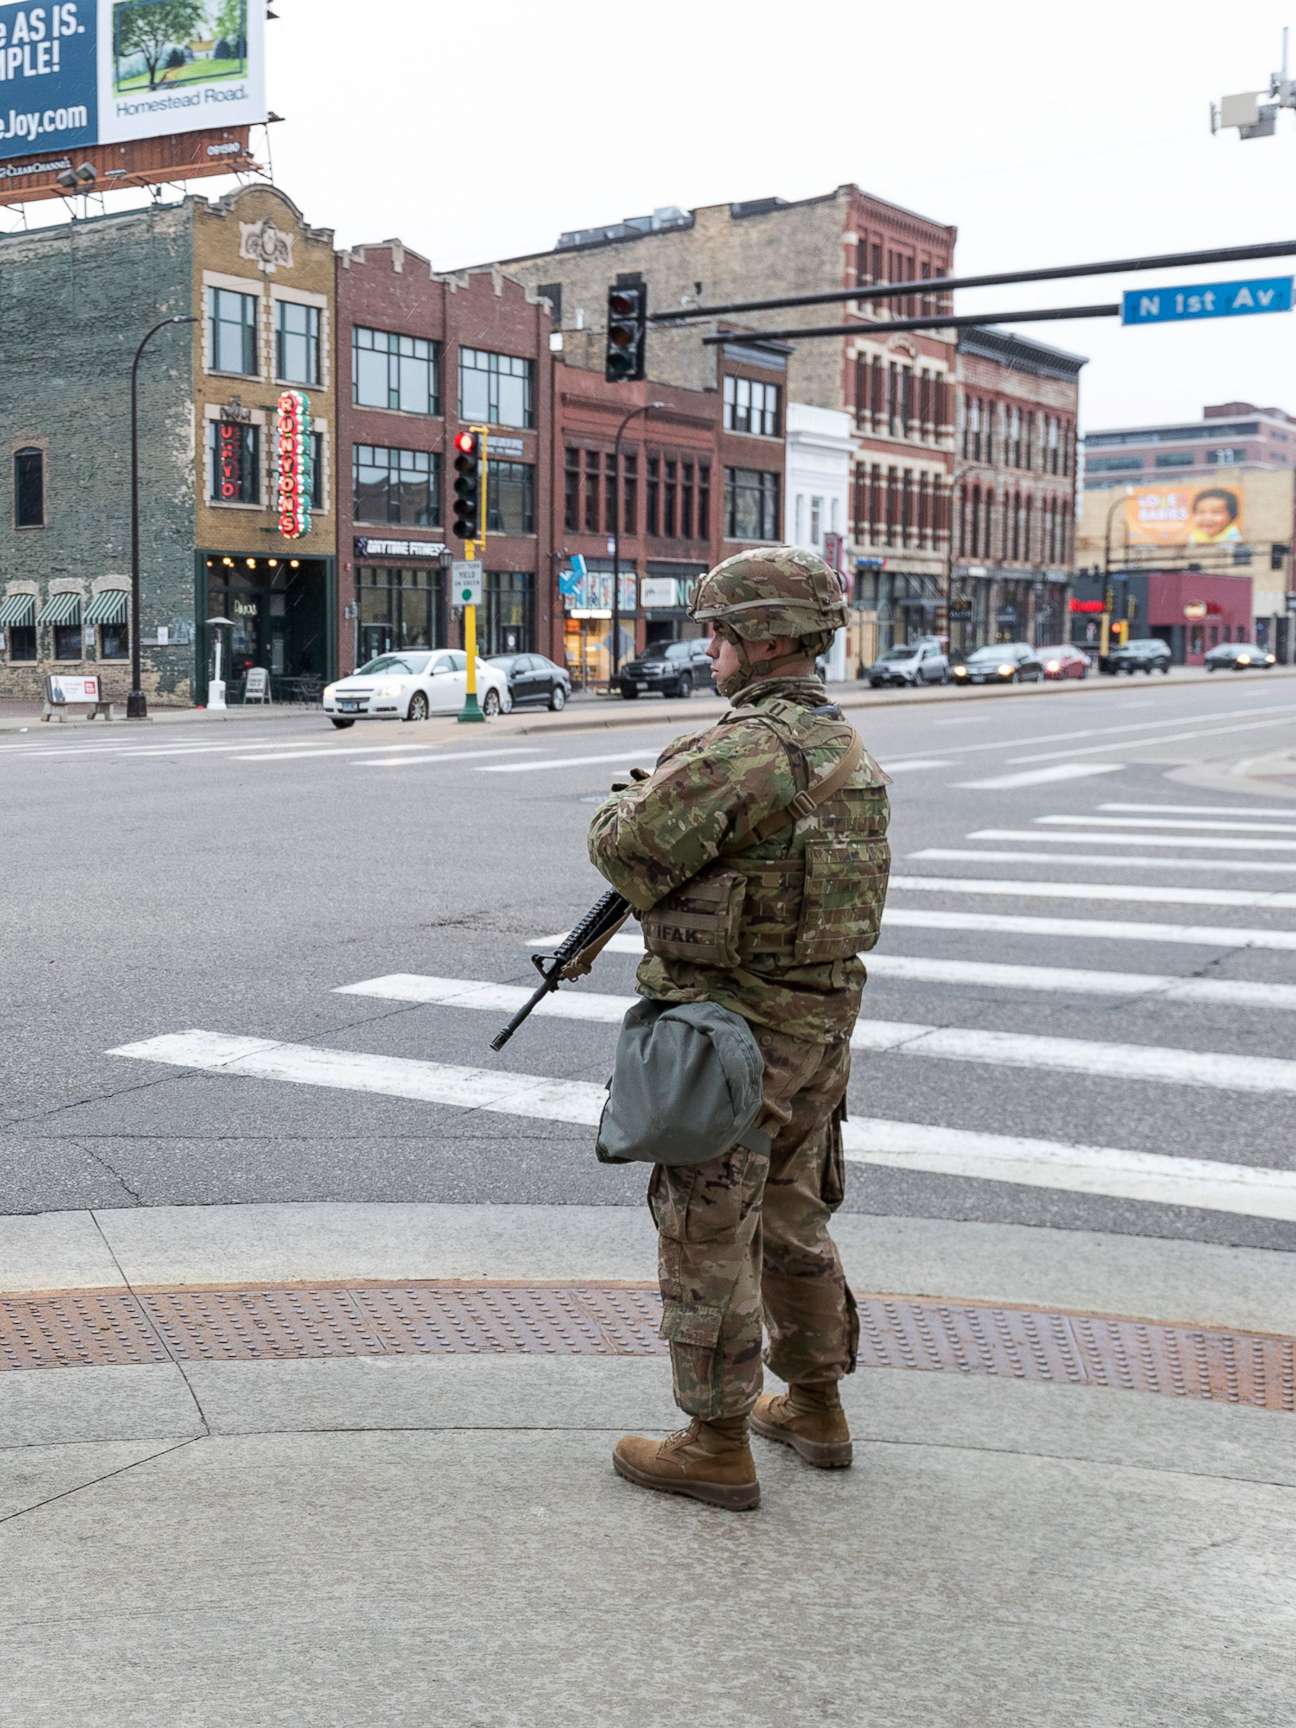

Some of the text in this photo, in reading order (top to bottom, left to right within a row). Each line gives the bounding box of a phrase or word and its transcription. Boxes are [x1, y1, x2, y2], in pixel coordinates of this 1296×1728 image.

[11, 8, 47, 45] AS
[52, 2, 86, 38] IS.
[116, 91, 201, 118] Homestead
[1139, 286, 1275, 317] N 1st Av
[280, 397, 296, 533] RUNYONS
[656, 924, 696, 944] IFAK
